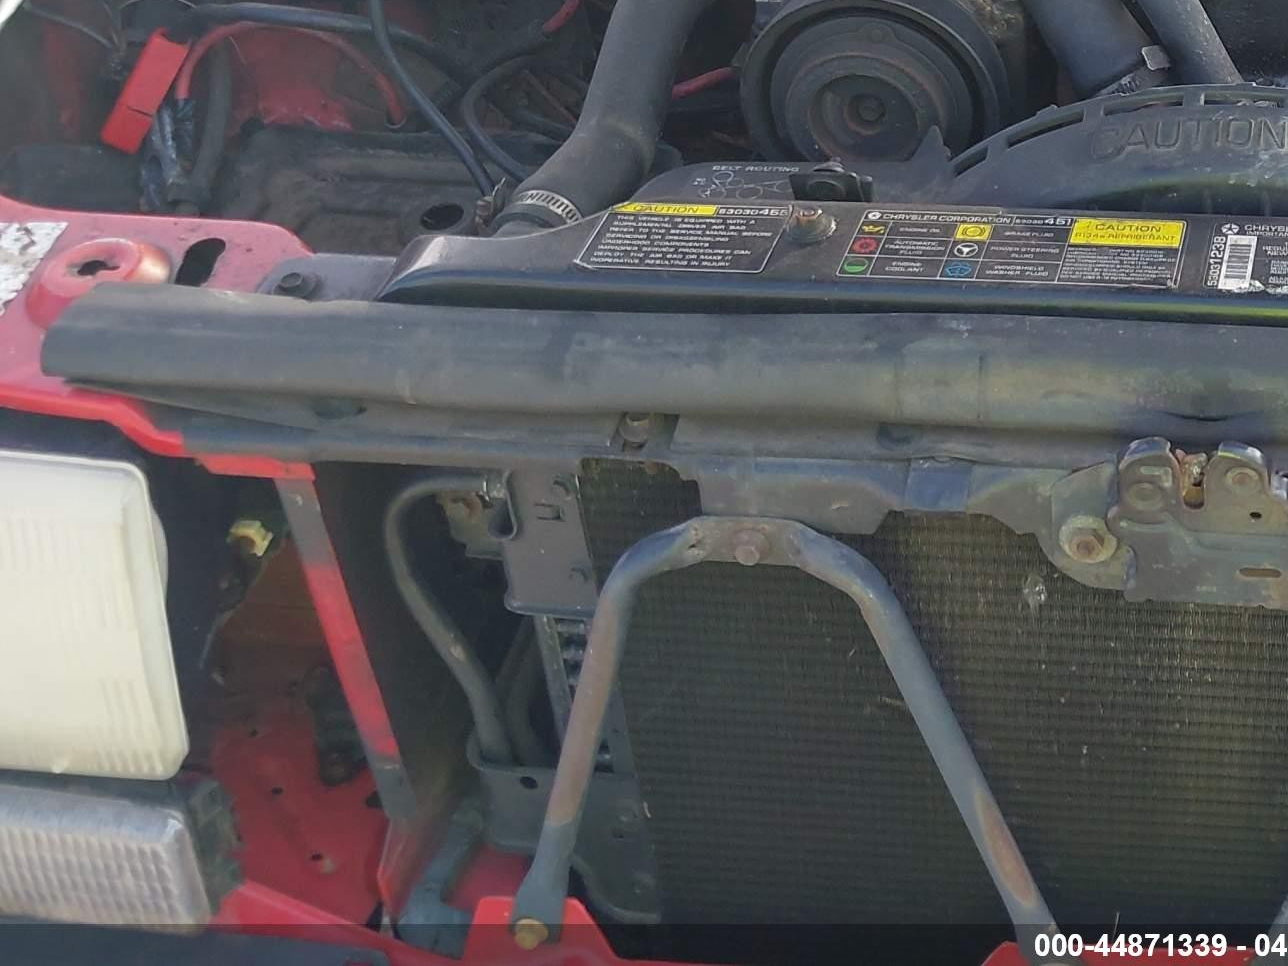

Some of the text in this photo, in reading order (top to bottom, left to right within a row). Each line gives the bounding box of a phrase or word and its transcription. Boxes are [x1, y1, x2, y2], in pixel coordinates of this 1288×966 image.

[1090, 118, 1288, 161] CAUTION
[633, 205, 699, 214] CAUTION
[882, 213, 1011, 224] CHRYSLER CORPORATION
[1095, 223, 1161, 233] CAUTION
[1107, 233, 1176, 241] REFRIGERANT
